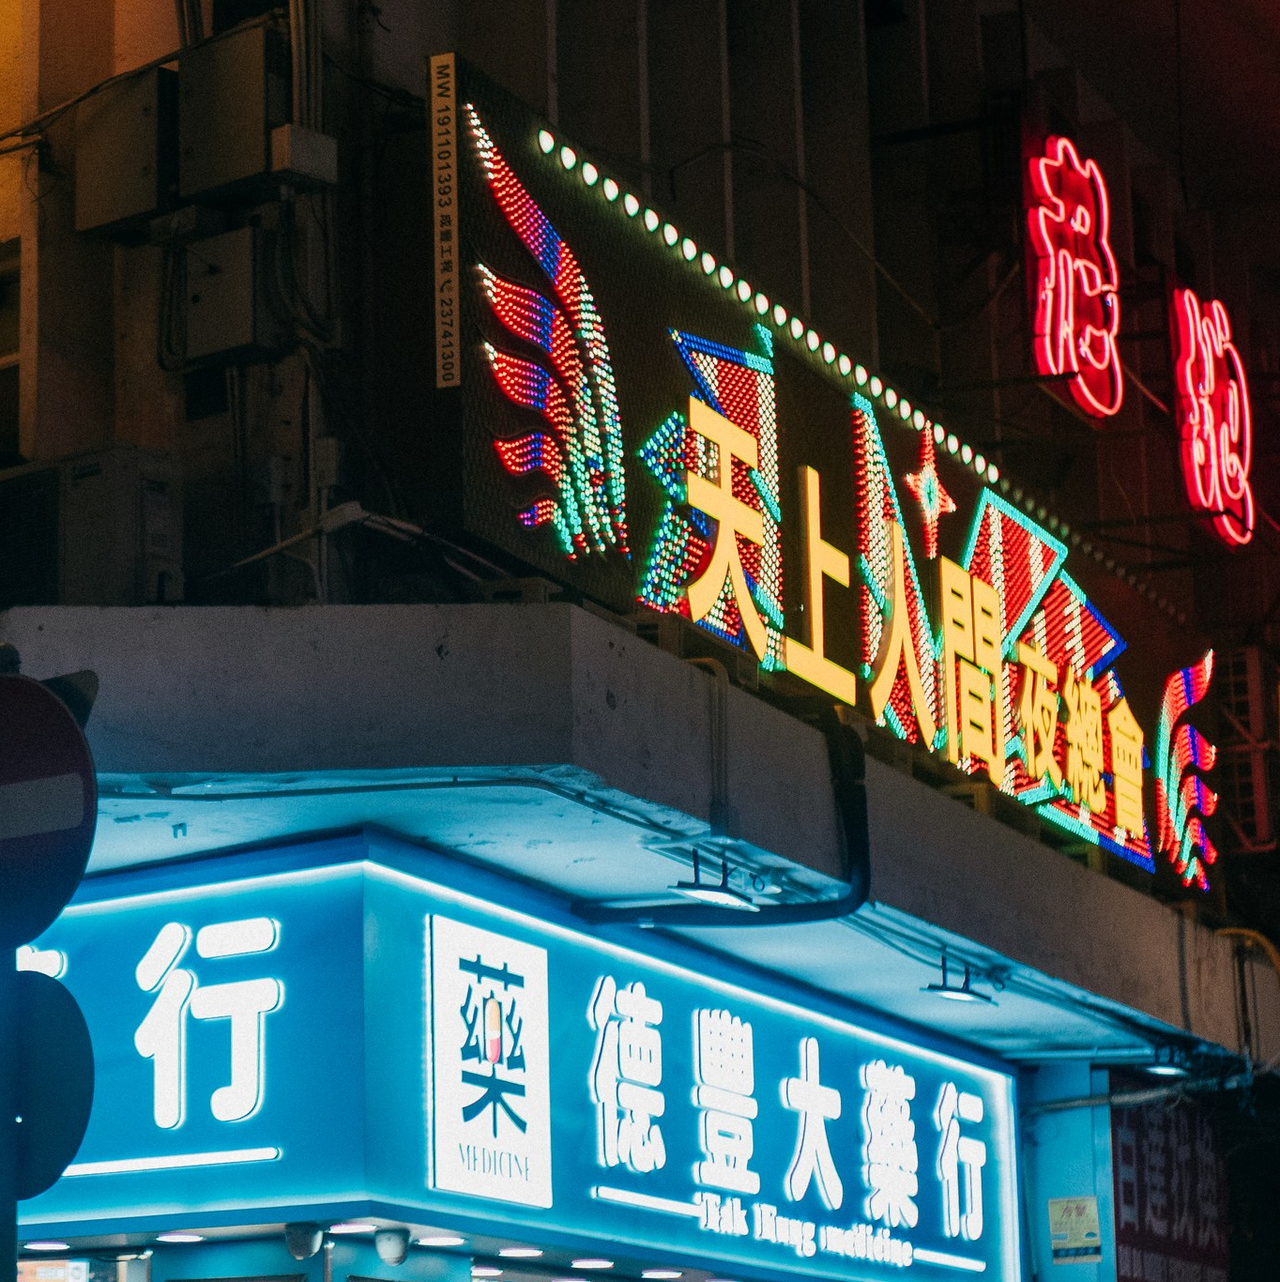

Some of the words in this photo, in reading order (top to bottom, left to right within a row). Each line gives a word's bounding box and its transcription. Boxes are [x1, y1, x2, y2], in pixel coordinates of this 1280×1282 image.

[436, 64, 451, 99] MW
[437, 104, 452, 208] 191101393
[439, 297, 455, 383] 23741300
[686, 397, 1145, 839] 天上人間夜總會
[458, 954, 528, 1138] 藥
[588, 974, 985, 1241] 德豐大藥行
[458, 1141, 531, 1183] MEDICINE
[699, 1191, 748, 1235] Tak
[755, 1202, 816, 1257] Fung
[819, 1218, 914, 1267] medicine
